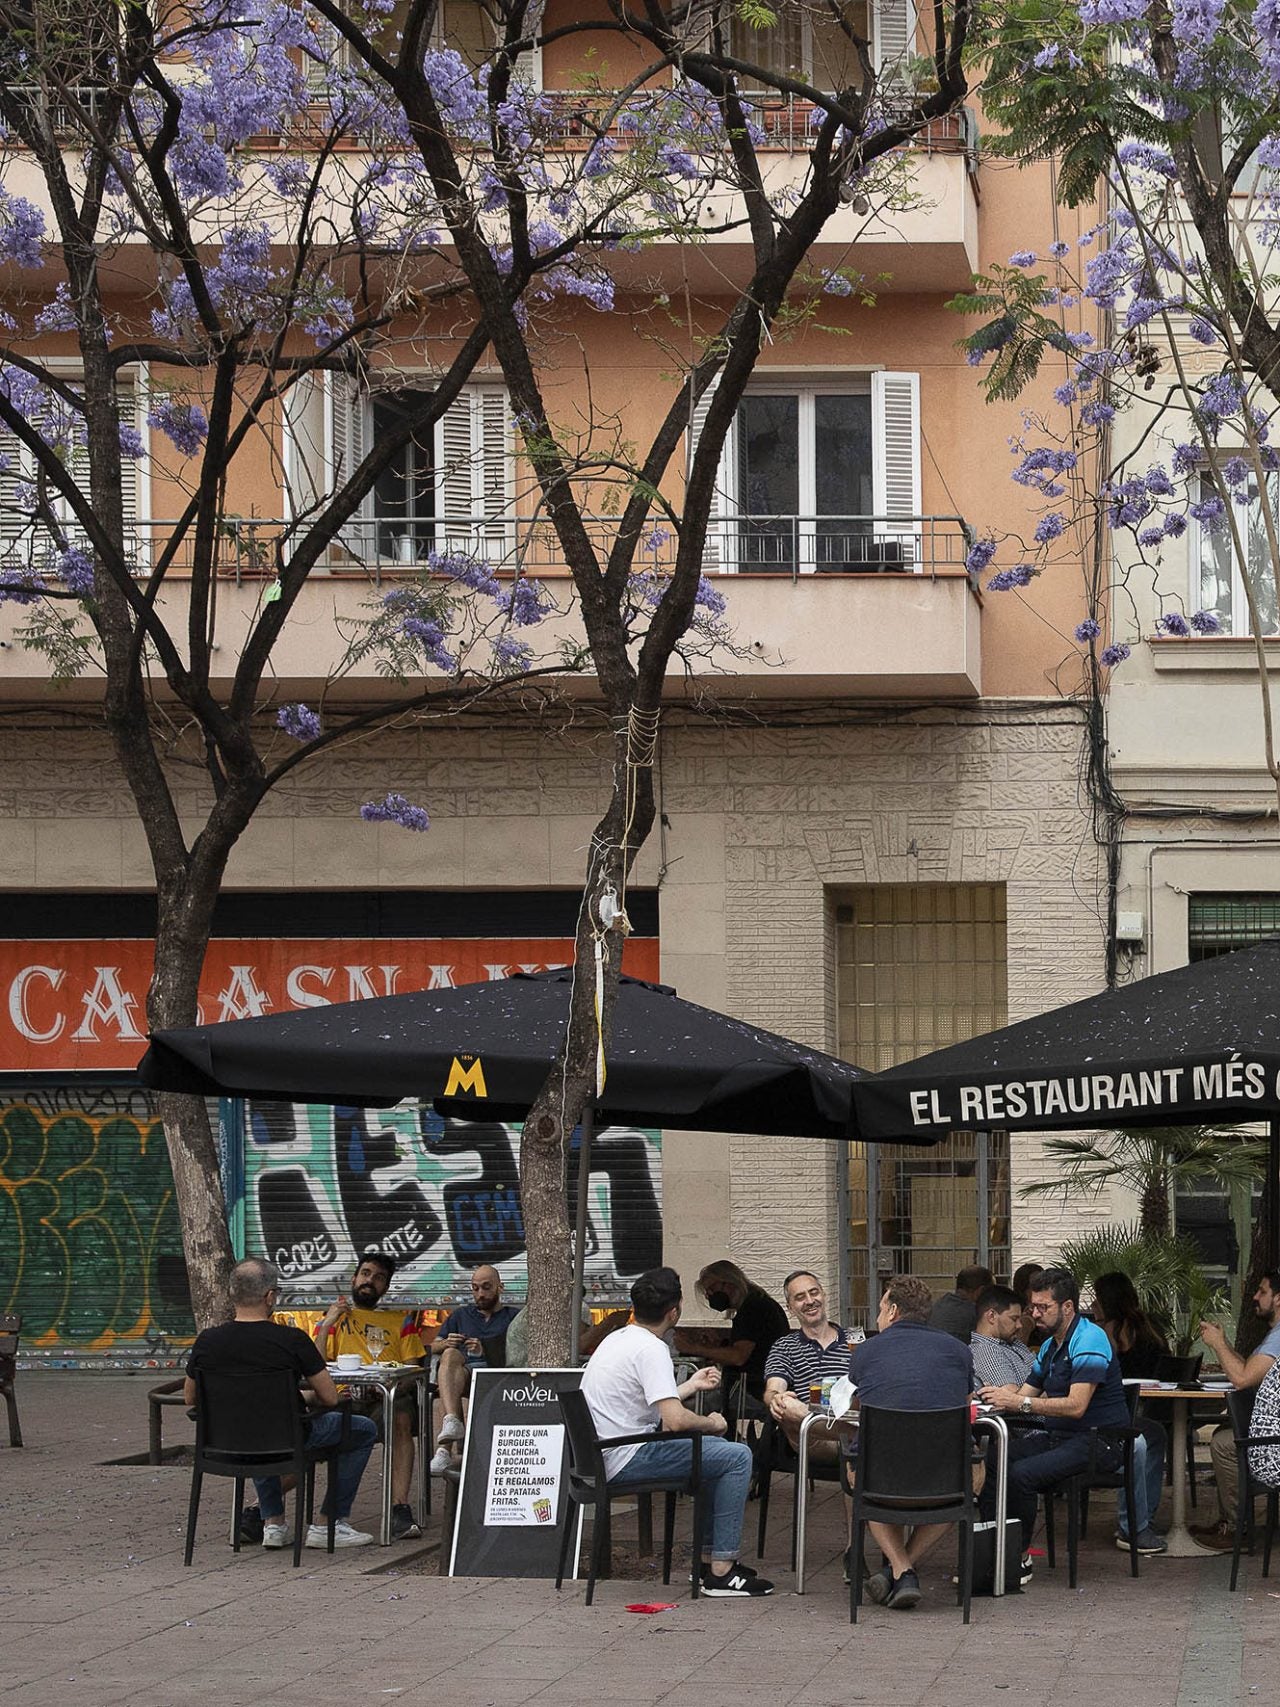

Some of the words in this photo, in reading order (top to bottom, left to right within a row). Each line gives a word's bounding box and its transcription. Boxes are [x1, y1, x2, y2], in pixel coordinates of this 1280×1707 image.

[443, 1056, 487, 1097] M
[910, 1090, 951, 1125] EL
[960, 1068, 1184, 1121] RESTAURANT
[1193, 1053, 1265, 1100] MÉS
[499, 1429, 507, 1438] SI
[508, 1429, 531, 1438] PIDES
[532, 1429, 549, 1437] UNA
[497, 1448, 540, 1456] SALCHICHA
[496, 1457, 502, 1465] O
[504, 1457, 546, 1465] BOCADILLO
[495, 1467, 530, 1475] ESPECIAL
[494, 1477, 504, 1486] TE
[505, 1477, 555, 1486] REGALAMOS
[492, 1488, 507, 1496] LAS
[509, 1487, 541, 1496] PATATAS
